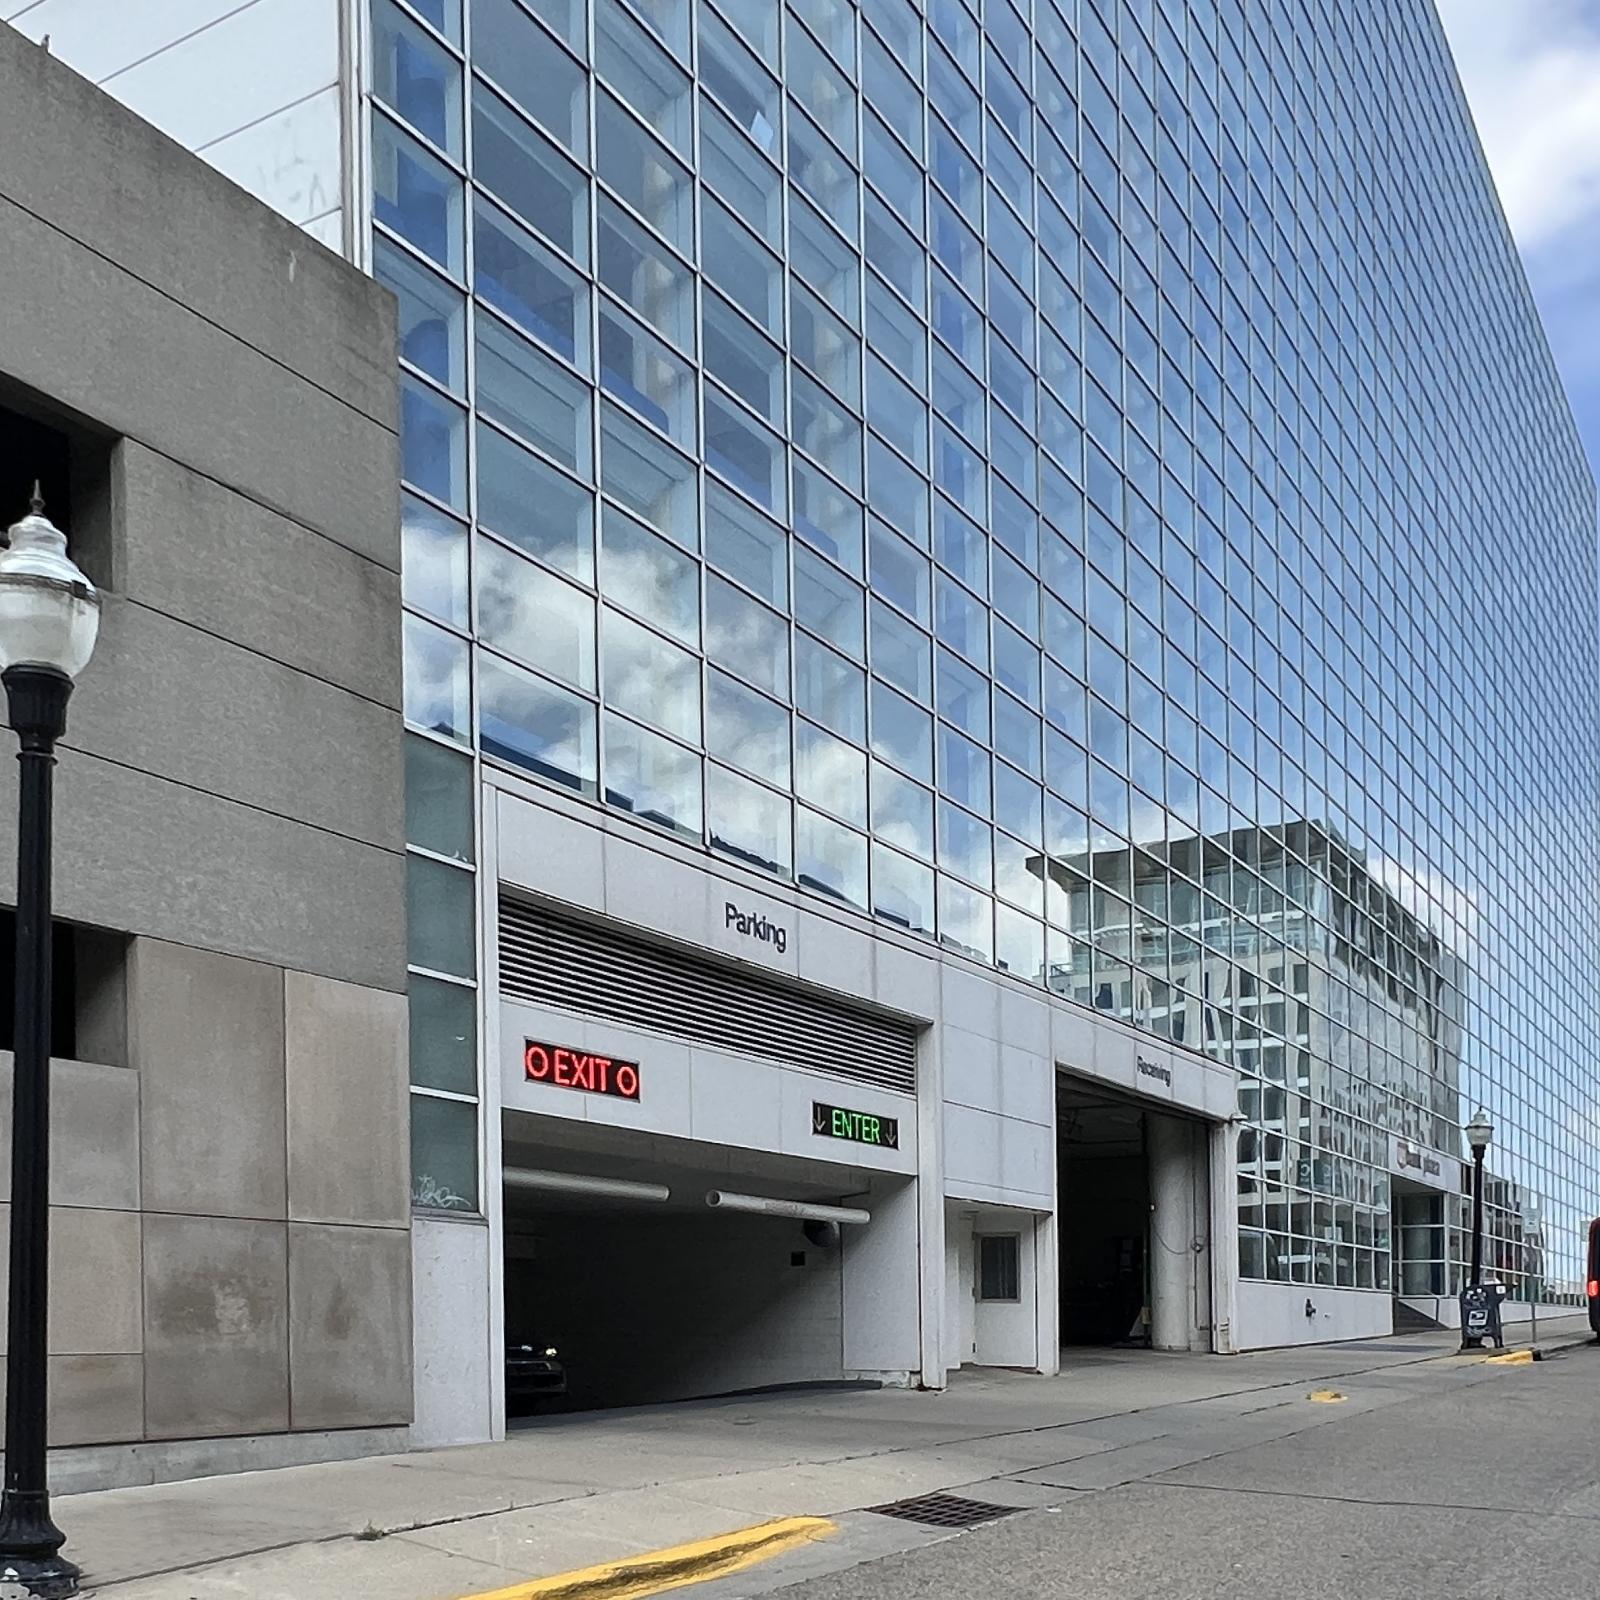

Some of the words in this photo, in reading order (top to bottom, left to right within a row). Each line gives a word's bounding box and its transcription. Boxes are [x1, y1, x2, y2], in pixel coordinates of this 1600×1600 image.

[725, 901, 787, 954] Parking
[554, 1049, 612, 1092] EXIT
[831, 1108, 881, 1144] ENTER
